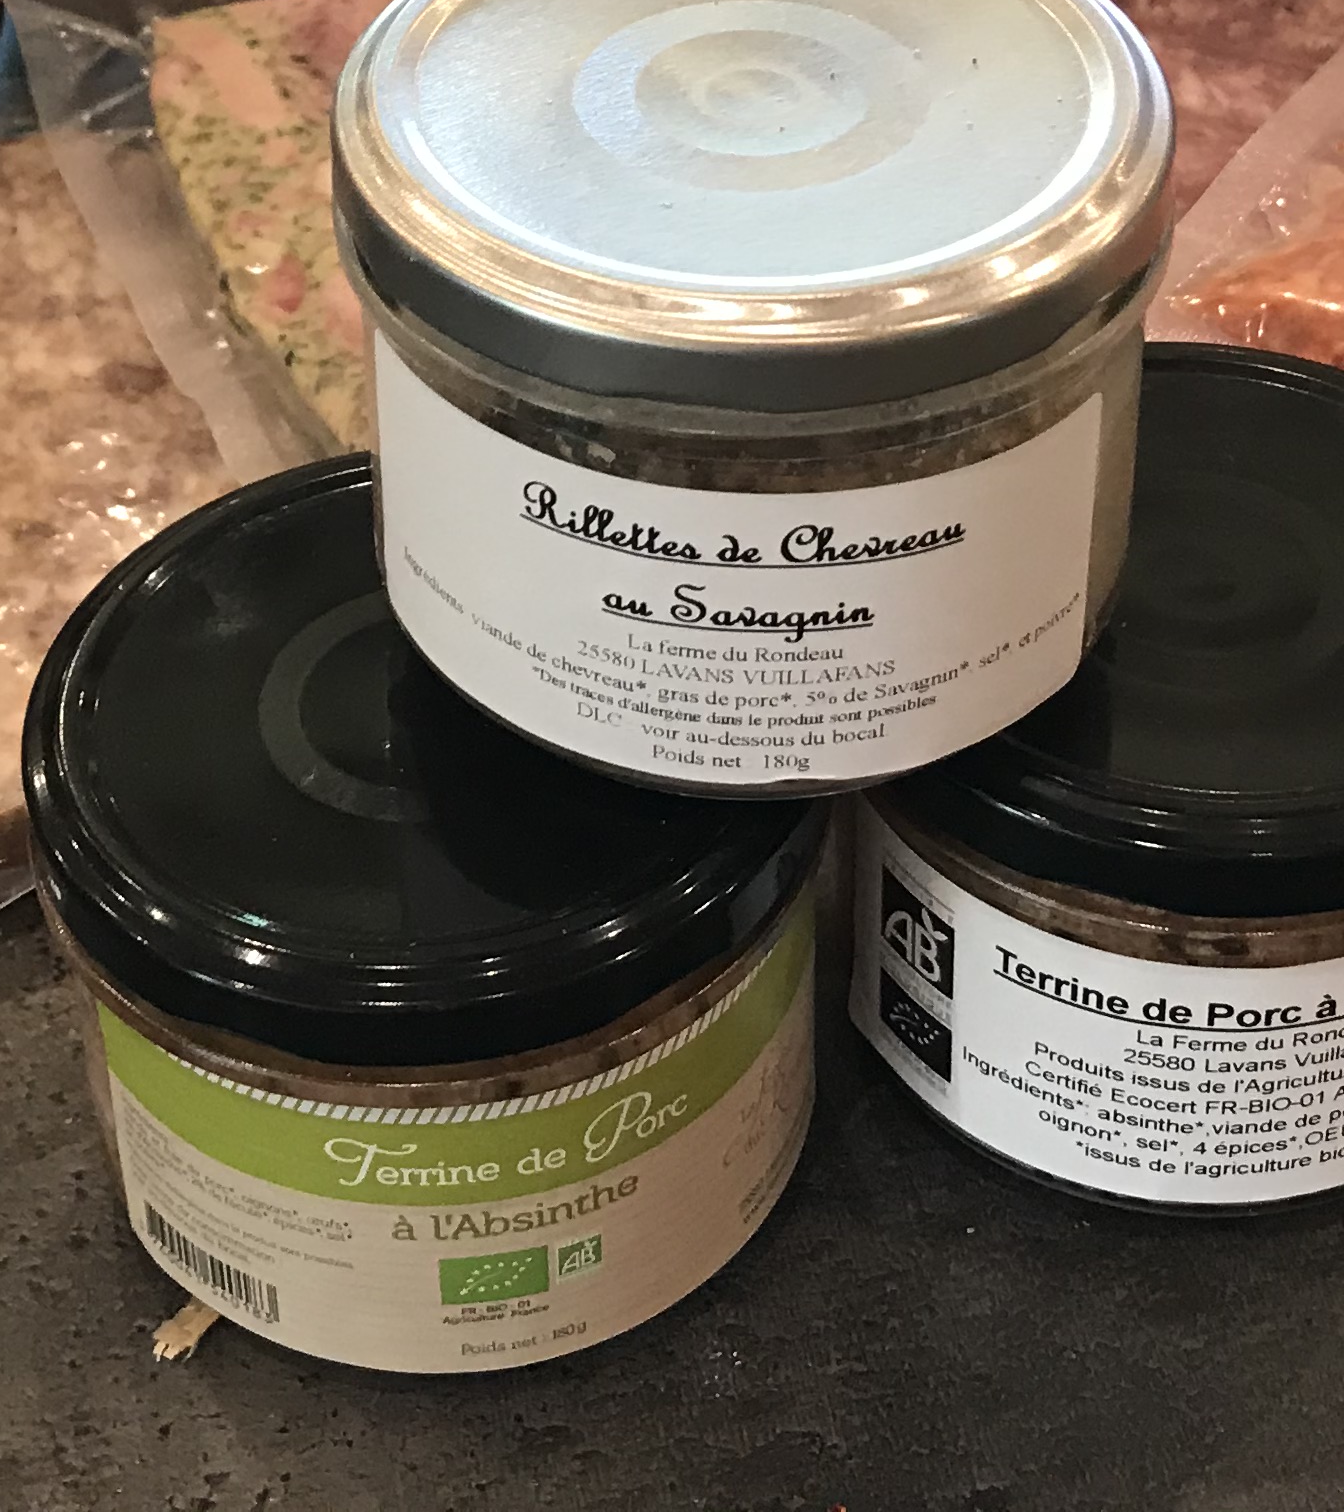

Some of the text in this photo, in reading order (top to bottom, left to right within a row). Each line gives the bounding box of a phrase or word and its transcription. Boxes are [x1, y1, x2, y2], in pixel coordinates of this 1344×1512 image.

[523, 481, 966, 562] Rillettes de Chevreau
[602, 584, 875, 644] au Savagnin
[471, 613, 523, 650] viande
[526, 644, 547, 663] de
[657, 688, 699, 703] gras
[705, 690, 730, 706] de
[843, 687, 868, 704] de
[577, 640, 896, 685] 25580 LAVANS VUILLAFANS
[628, 633, 844, 663] La ferme du Rondeau
[570, 681, 614, 705] traces
[706, 710, 743, 726] dans
[748, 714, 762, 726] le
[829, 710, 862, 724] sont
[868, 695, 937, 721] possibles
[641, 724, 680, 740] voir
[686, 731, 795, 747] au-dessous
[801, 731, 825, 746] du
[832, 723, 885, 743] bocal
[652, 744, 810, 772] Poids net 180g
[995, 944, 1129, 1015] Terrine
[1142, 998, 1193, 1024] de
[1207, 1002, 1302, 1027] Porc
[1315, 994, 1337, 1018] à
[1123, 1048, 1196, 1072] 25580
[1205, 1058, 1287, 1074] Lavans
[1136, 1030, 1163, 1047] La
[1173, 1034, 1248, 1052] Ferme
[1255, 1037, 1284, 1052] du
[1025, 1060, 1103, 1098] Certifié
[1111, 1087, 1197, 1115] Ecocert
[1205, 1091, 1325, 1115] FR-BIO-01
[1034, 1041, 1125, 1083] Produits
[1131, 1074, 1190, 1092] issus
[1197, 1080, 1226, 1094] de
[323, 1137, 500, 1187] Terrine
[517, 1146, 566, 1176] de
[583, 1091, 688, 1164] Porc
[1294, 1108, 1321, 1129] de
[1148, 1160, 1176, 1174] de
[1185, 1156, 1312, 1178] l'agriculture
[1192, 1142, 1207, 1155] 4
[391, 1175, 640, 1241] à l'Absinthe
[461, 1340, 506, 1356] Poids
